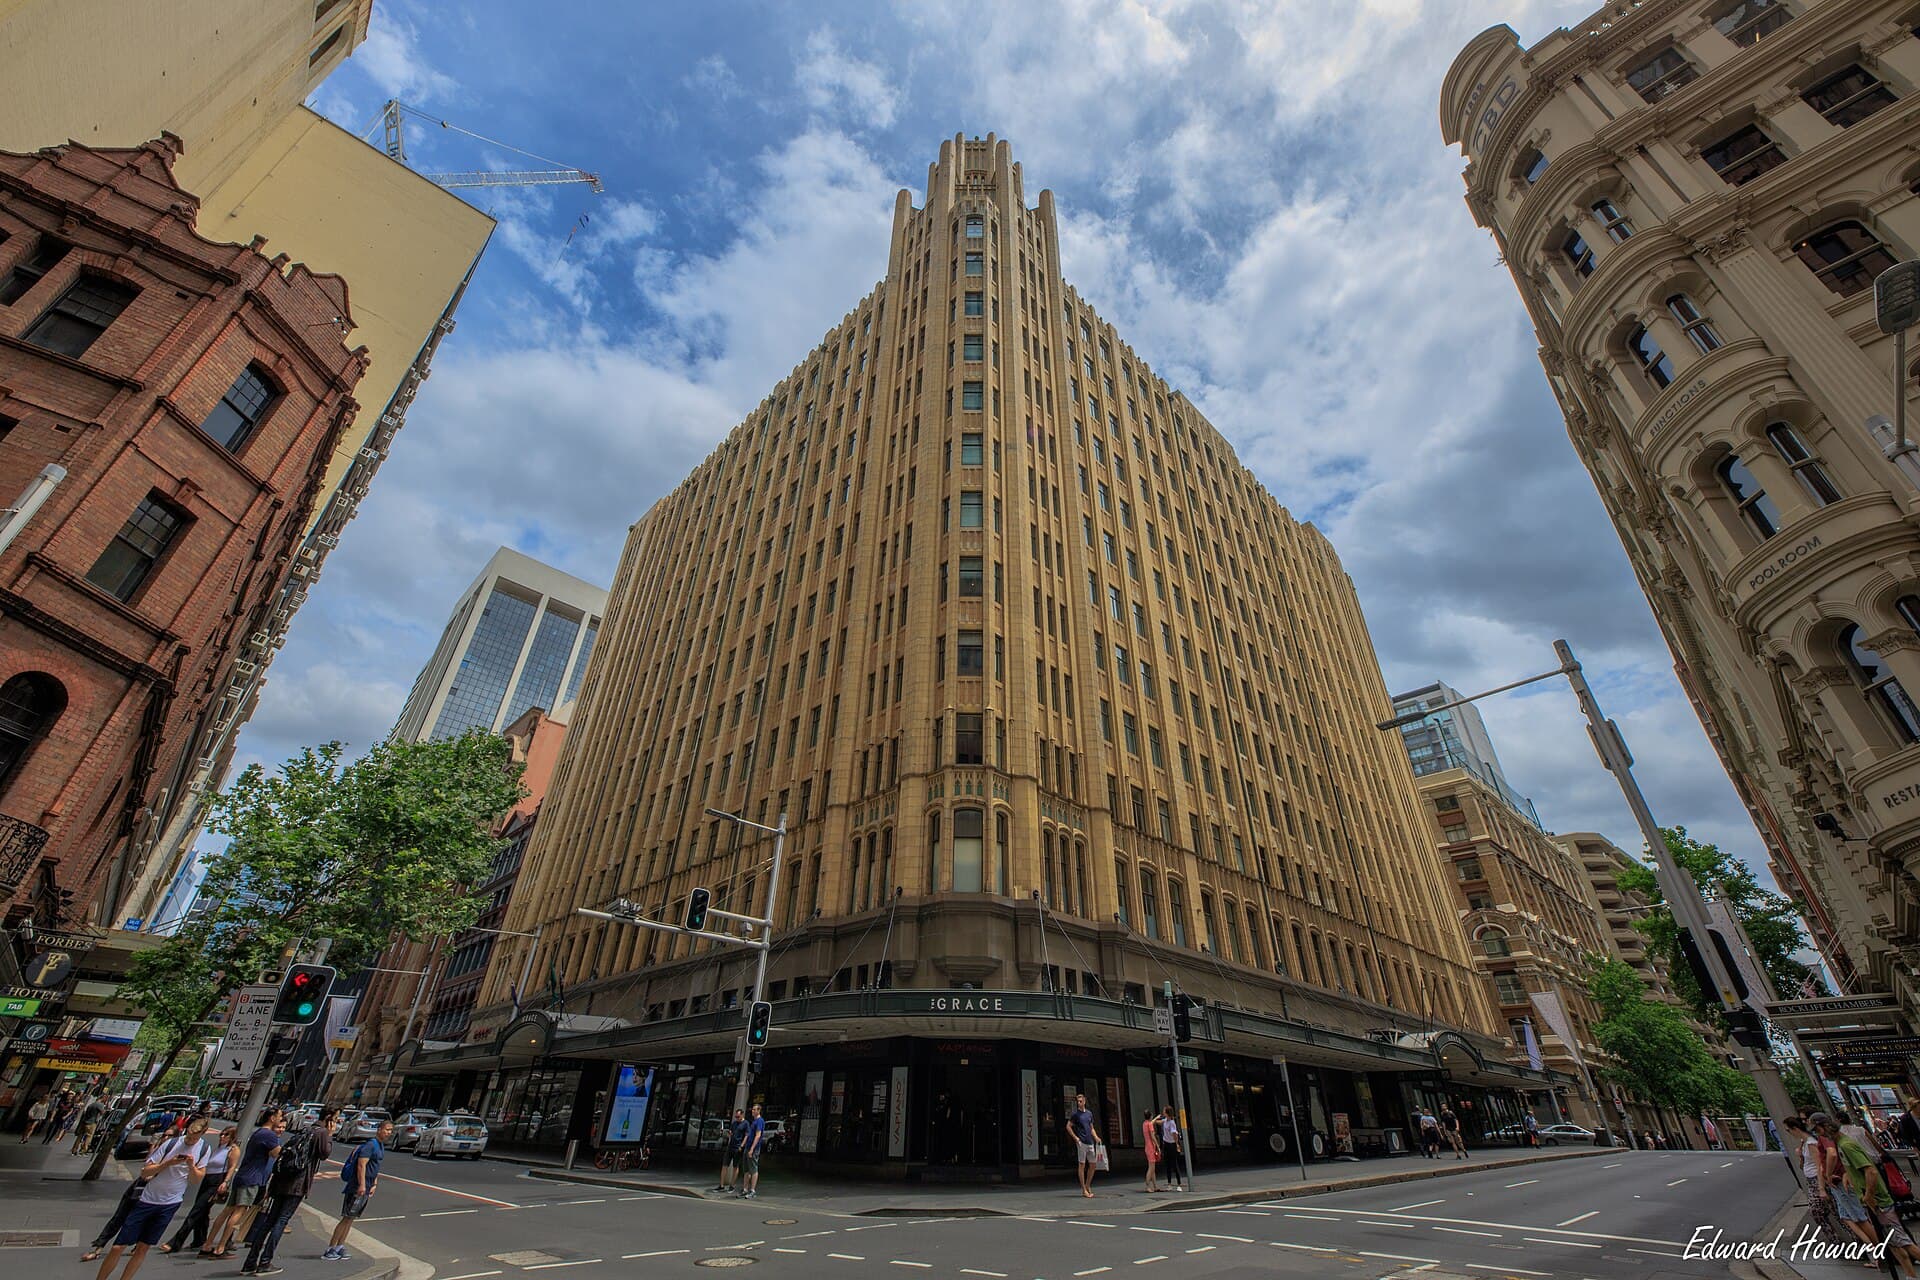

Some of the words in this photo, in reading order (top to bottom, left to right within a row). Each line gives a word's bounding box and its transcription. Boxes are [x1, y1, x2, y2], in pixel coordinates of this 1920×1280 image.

[1475, 80, 1517, 155] CBD
[1650, 380, 1706, 437] FUNCTIONS
[1750, 565, 1779, 590] POOL
[1779, 536, 1821, 568] ROOM
[36, 935, 94, 950] FORBES
[8, 987, 60, 1001] HOTEL
[7, 1002, 23, 1010] TAB
[239, 1006, 271, 1014] LANE
[937, 998, 1003, 1010] GRACE
[1779, 1003, 1825, 1014] ROCKLIFF
[1826, 999, 1884, 1010] CHAMBERS
[893, 1080, 902, 1145] VAPIANO
[1025, 1084, 1033, 1148] VAPIANO
